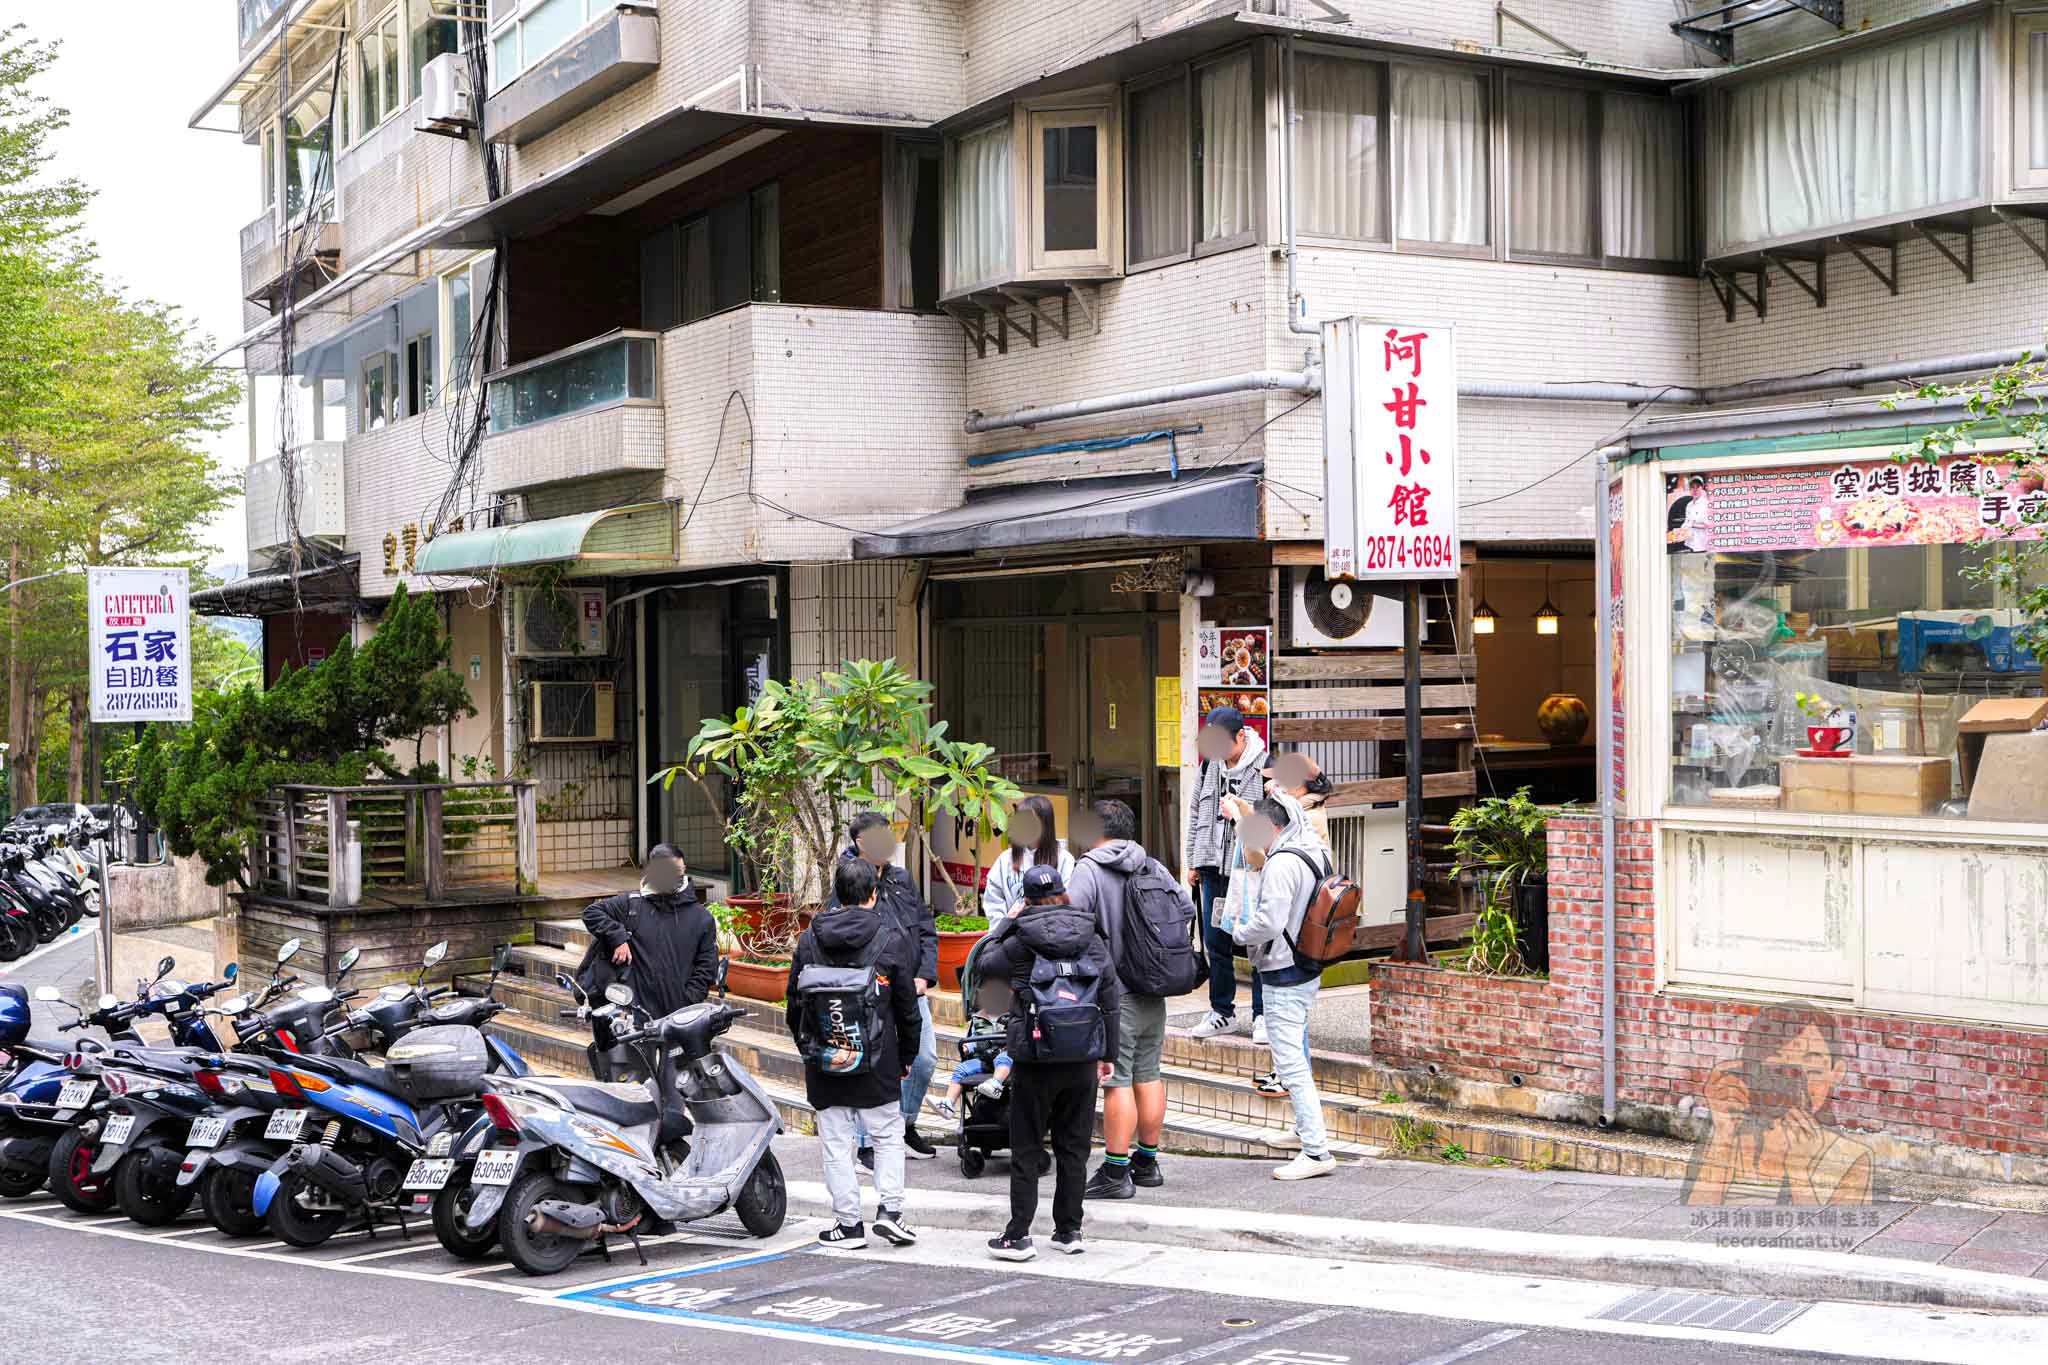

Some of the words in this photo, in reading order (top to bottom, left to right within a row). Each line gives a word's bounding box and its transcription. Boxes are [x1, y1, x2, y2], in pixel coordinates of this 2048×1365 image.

[1382, 328, 1431, 528] 阿甘小館
[1814, 470, 1832, 478] pizza
[1834, 463, 1978, 499] 窯烤披薩
[1985, 470, 1996, 485] &
[1802, 483, 1819, 492] pizza
[1804, 496, 1822, 505] pizza
[1794, 509, 1812, 518] pizza
[1794, 522, 1812, 531] pizza
[1779, 535, 1797, 544] pizza
[1367, 535, 1452, 569] 2874-6694
[105, 591, 175, 614] CAFETERIA
[105, 630, 177, 663] 石家
[106, 665, 178, 689] 自助餐
[106, 692, 178, 711] 28726956
[844, 1020, 864, 1052] THE
[406, 1168, 449, 1186] 390-KGZ
[473, 1160, 513, 1180] 830-HSR
